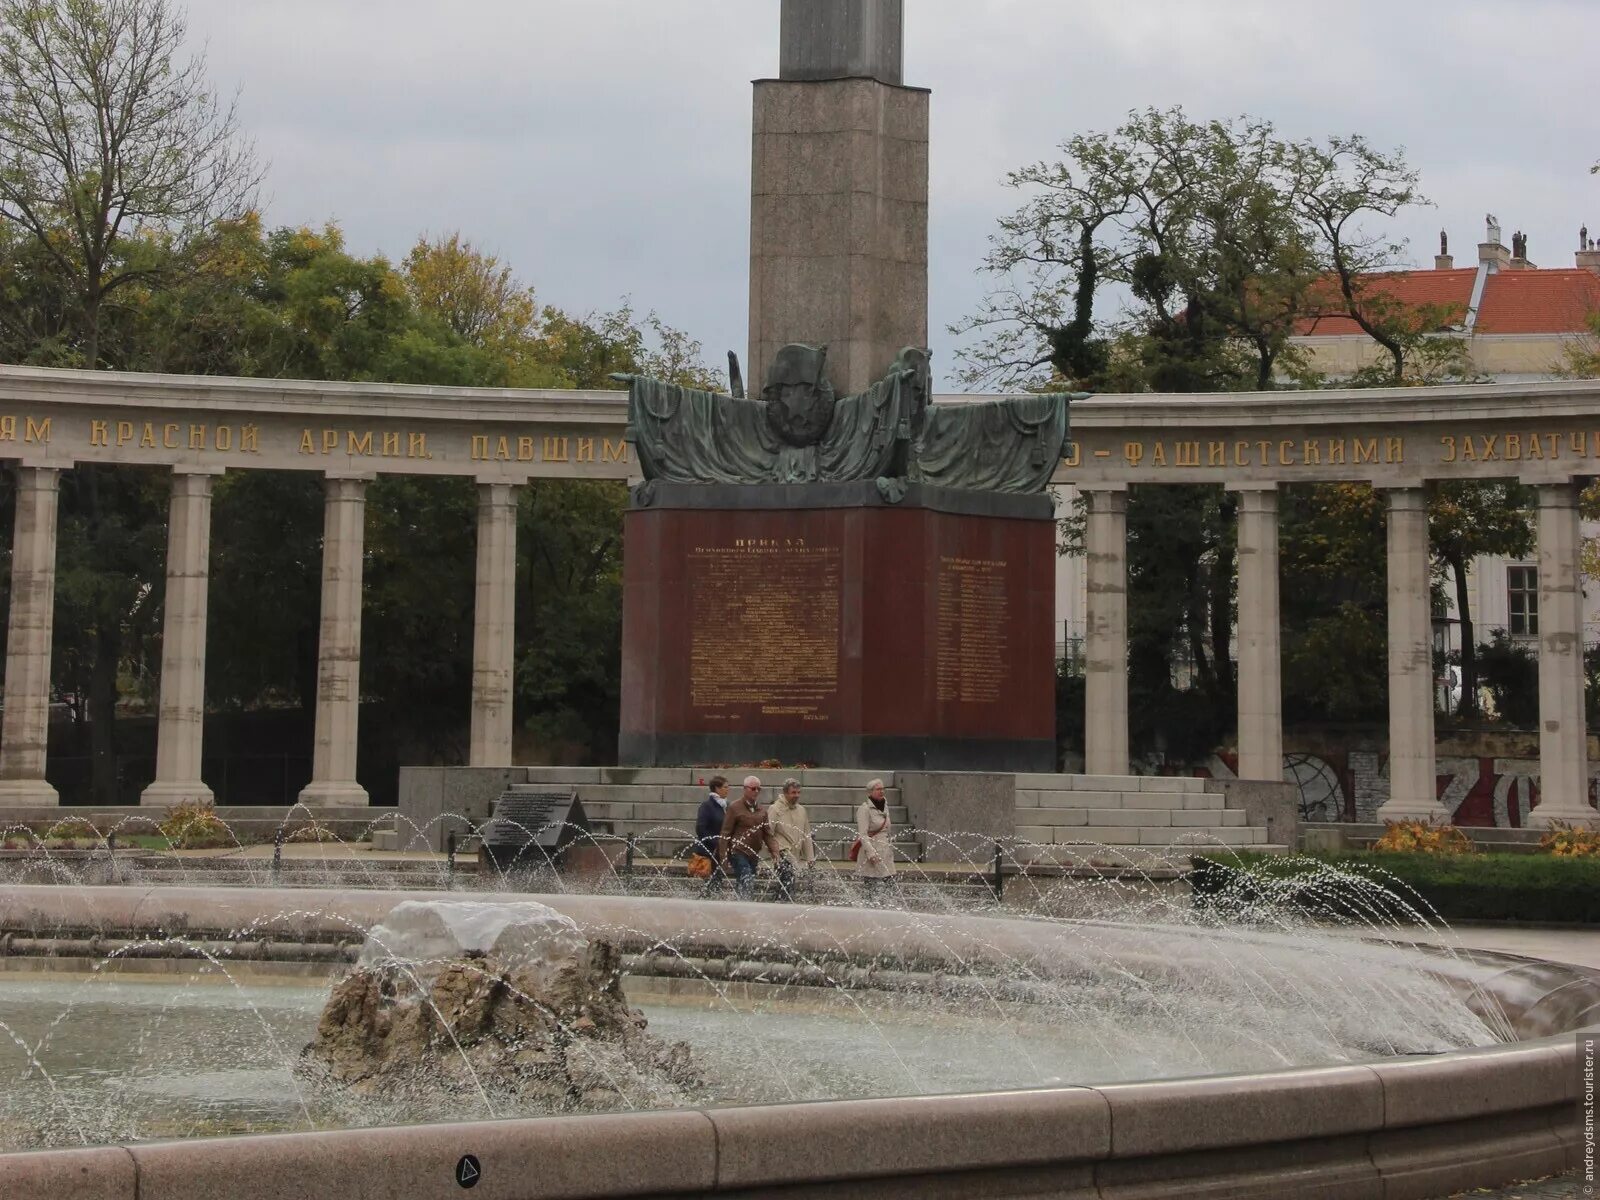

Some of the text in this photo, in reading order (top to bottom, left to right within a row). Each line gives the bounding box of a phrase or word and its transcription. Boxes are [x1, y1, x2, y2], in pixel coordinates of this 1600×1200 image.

[90, 419, 260, 452] КРАСНОЙ
[299, 429, 433, 459] АРМИИ,
[471, 435, 628, 464] ПАВШИМ
